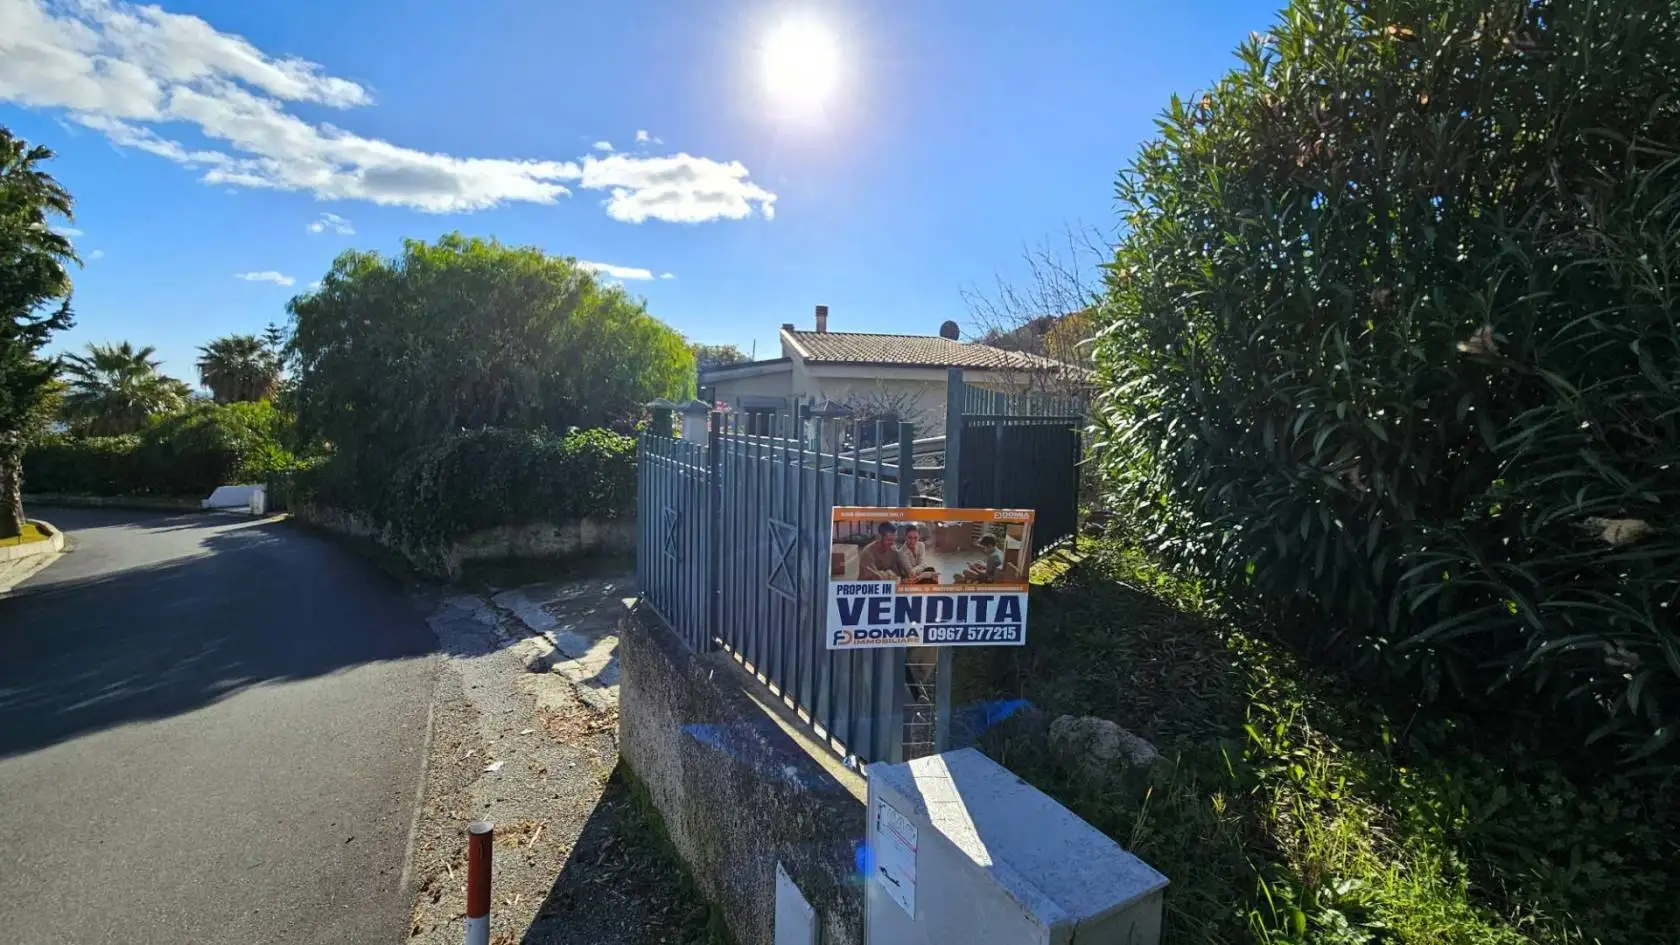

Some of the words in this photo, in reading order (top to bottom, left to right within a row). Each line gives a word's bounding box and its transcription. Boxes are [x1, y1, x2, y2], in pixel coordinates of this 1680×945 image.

[1002, 511, 1029, 519] DOMIA
[836, 584, 880, 595] PROPONE
[881, 583, 892, 595] IN
[836, 595, 1022, 626] VENDITA
[854, 627, 920, 639] DOMIA
[928, 627, 964, 641] 0967
[967, 627, 1017, 640] 577215
